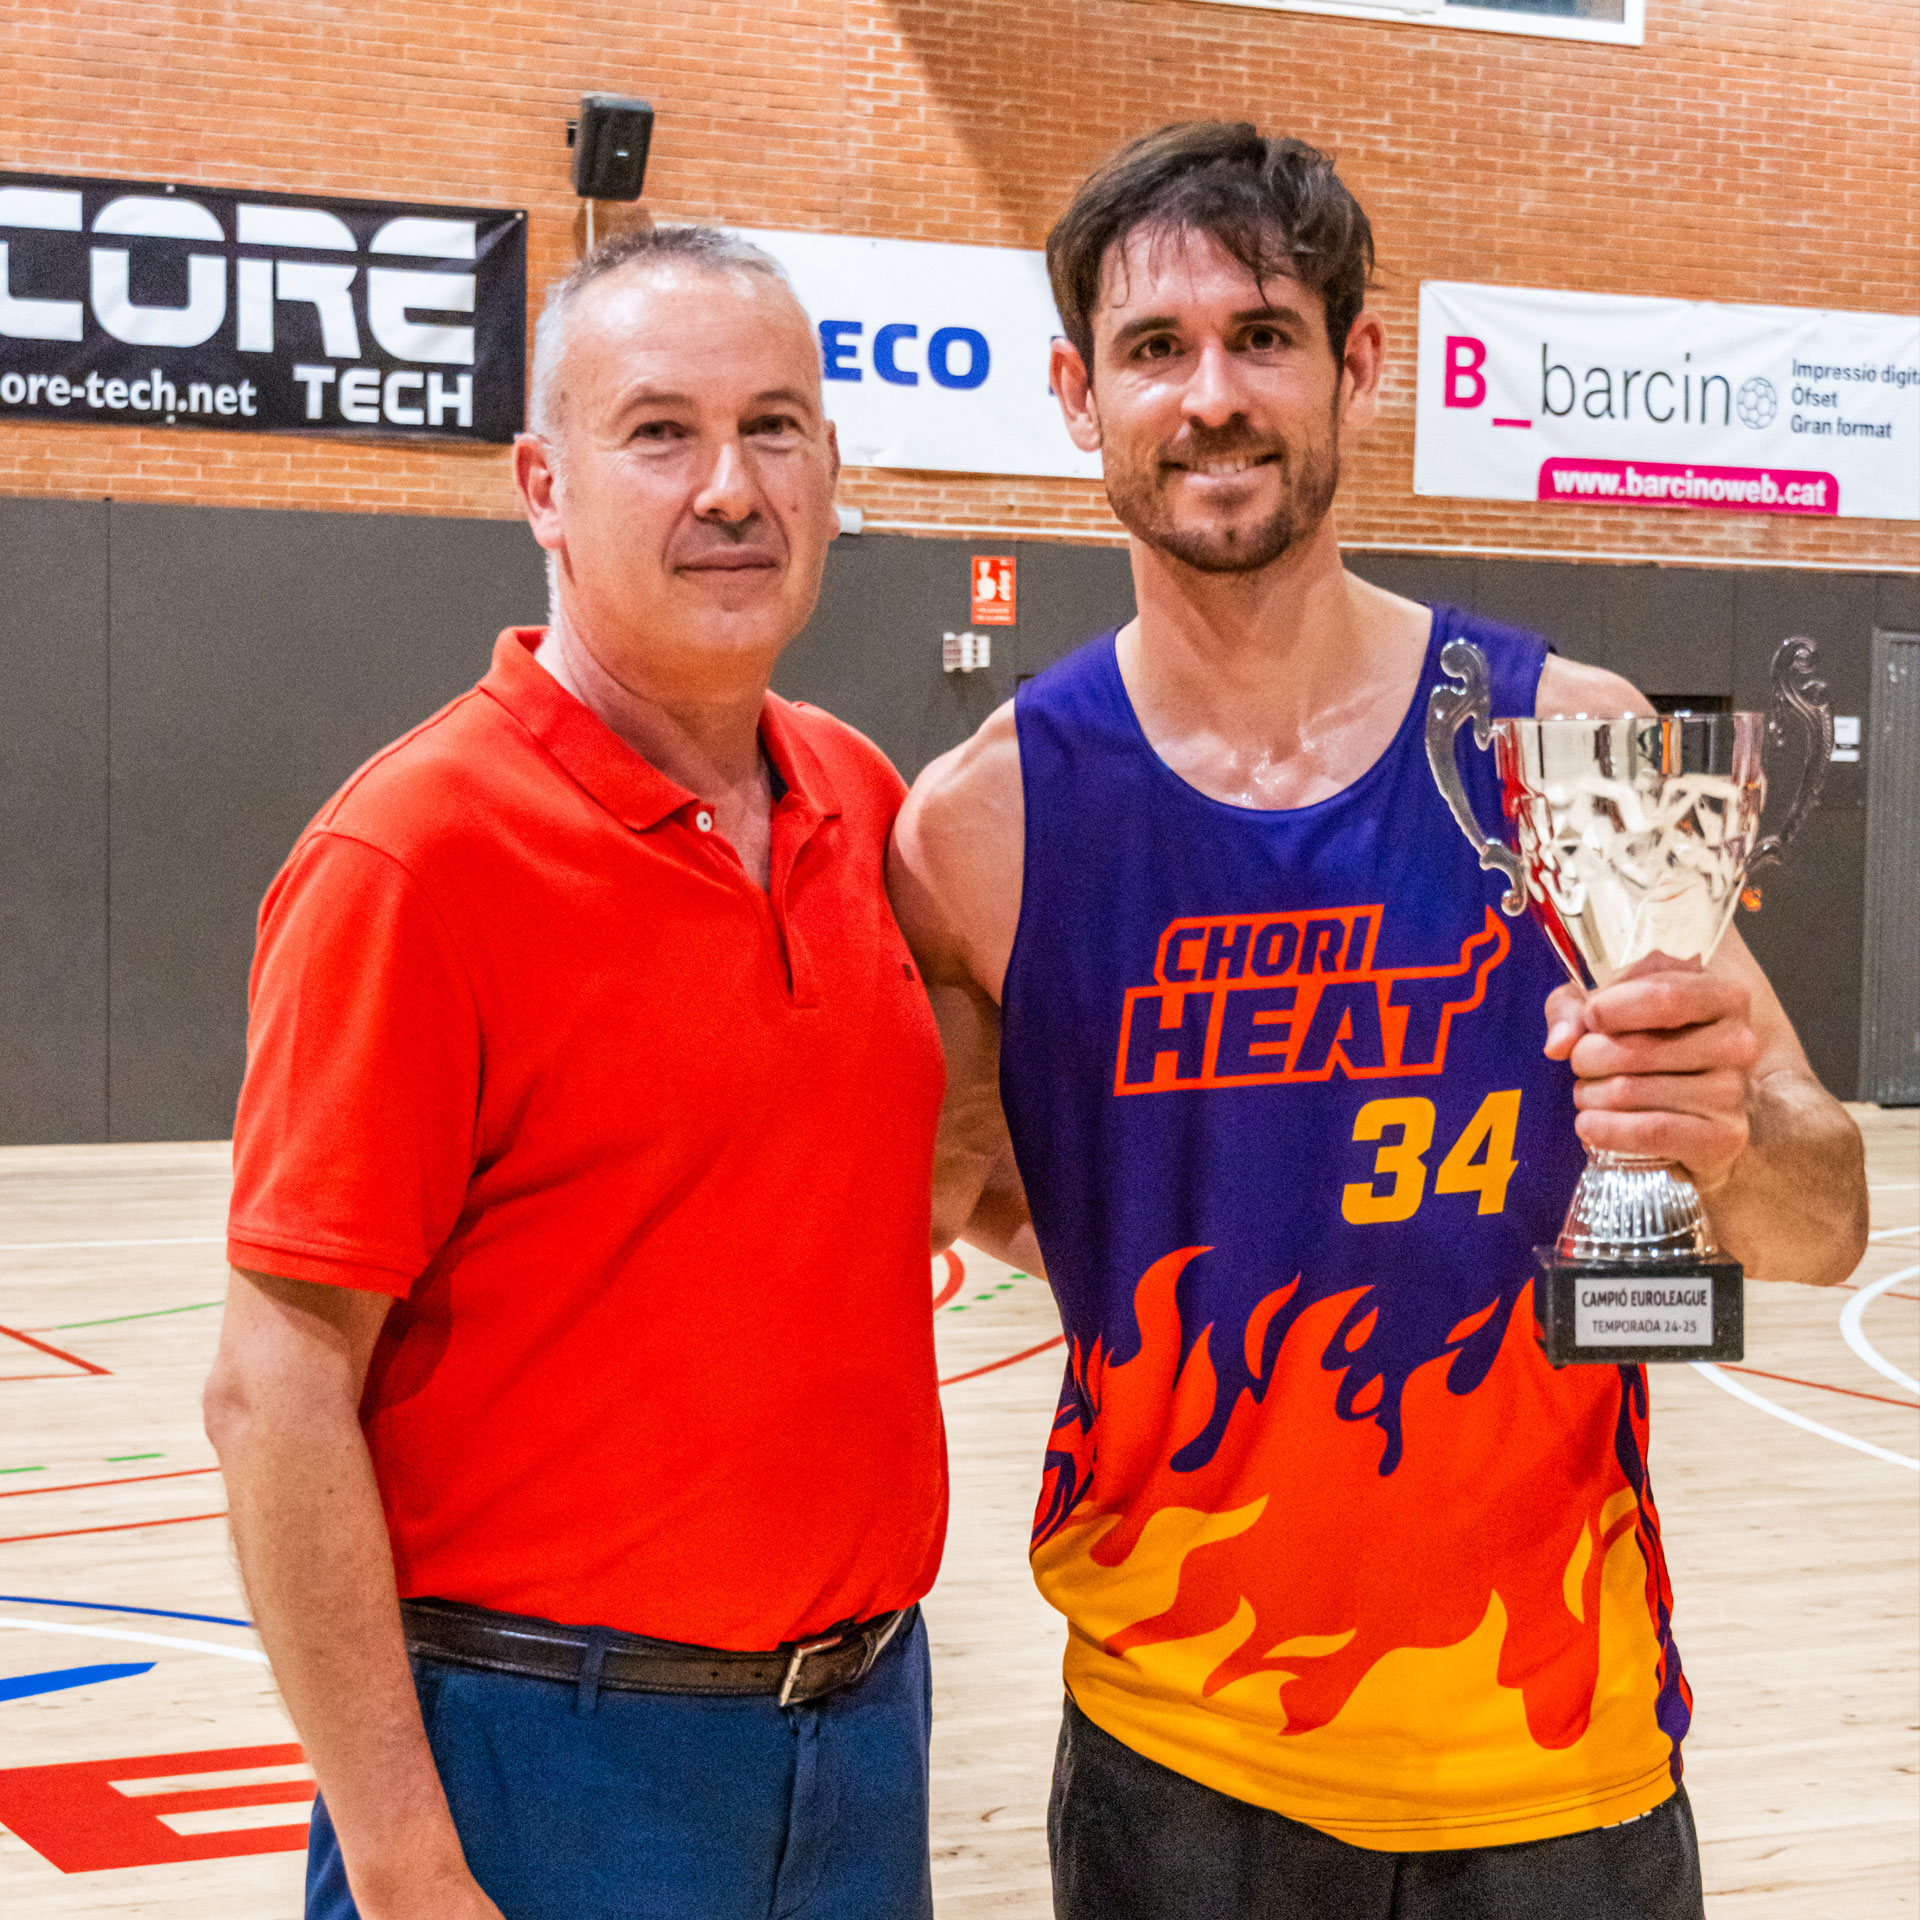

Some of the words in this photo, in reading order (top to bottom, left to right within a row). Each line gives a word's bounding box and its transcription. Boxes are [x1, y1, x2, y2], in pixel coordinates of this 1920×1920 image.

[0, 186, 477, 366] CORE
[293, 365, 474, 428] TECH
[1791, 414, 1832, 435] Gran
[1836, 416, 1892, 439] format
[1552, 466, 1827, 507] www.barcinoweb.cat
[1162, 916, 1372, 983] CHORI
[1123, 933, 1501, 1085] HEAT
[1341, 1089, 1522, 1225] 34
[1582, 1288, 1628, 1308] CAMPIÓ
[1631, 1289, 1708, 1307] EUROLEAGUE
[1593, 1319, 1661, 1334] TEMPORADA
[1664, 1320, 1697, 1334] 24-25
